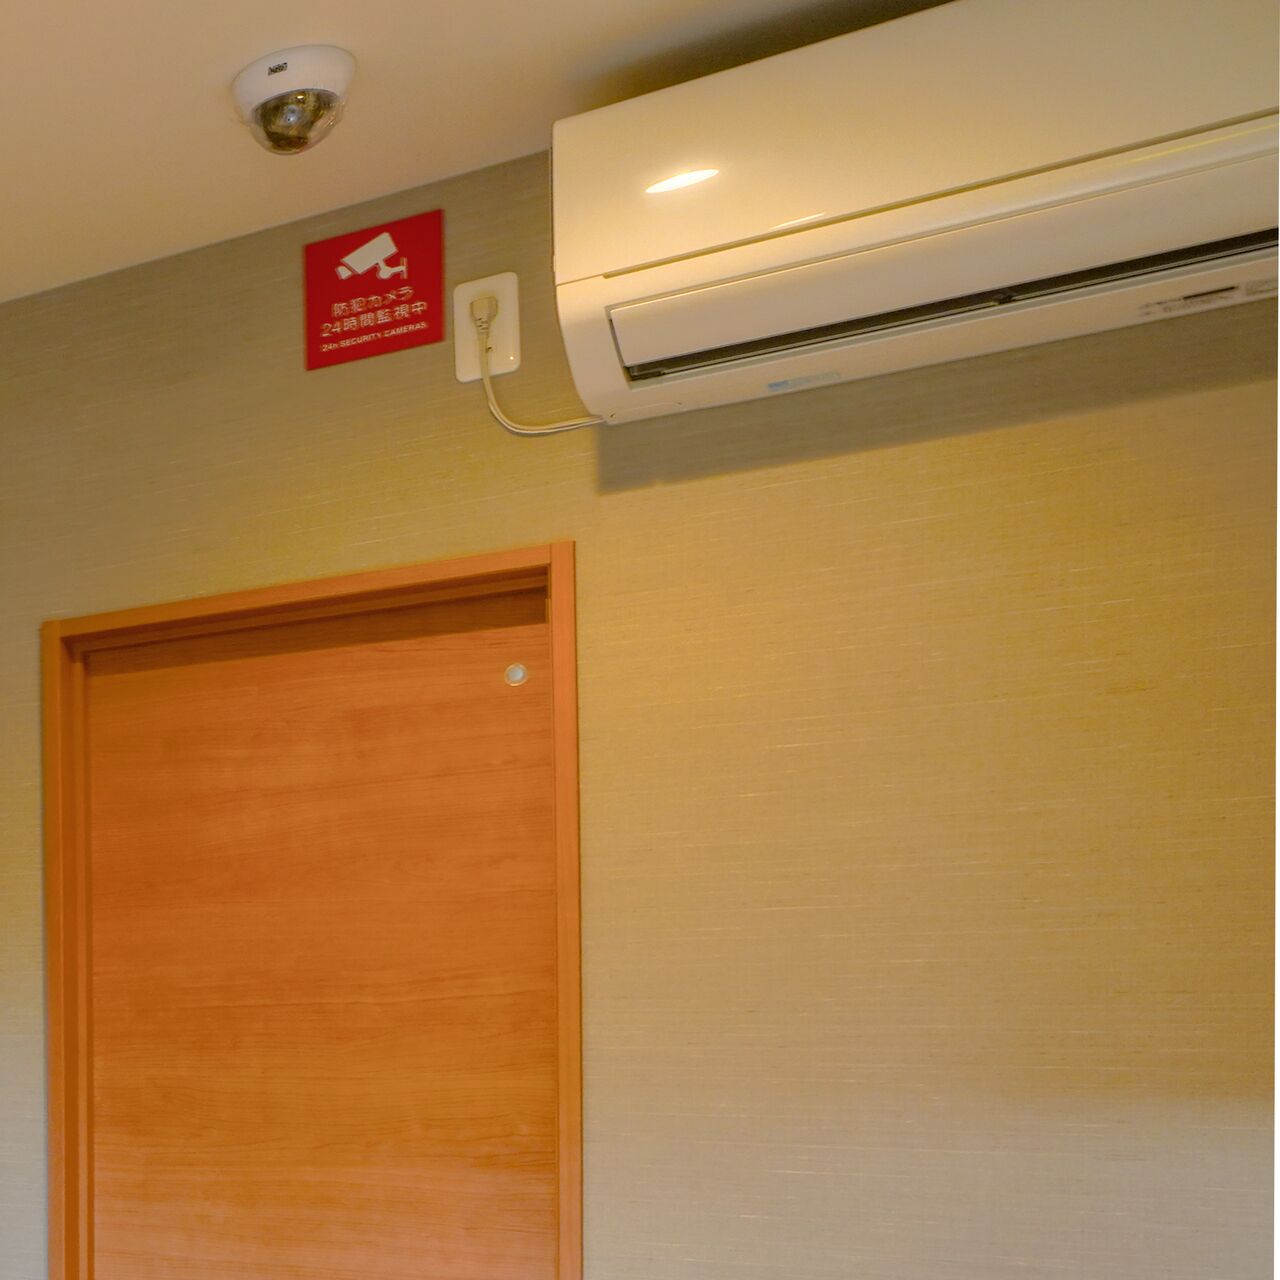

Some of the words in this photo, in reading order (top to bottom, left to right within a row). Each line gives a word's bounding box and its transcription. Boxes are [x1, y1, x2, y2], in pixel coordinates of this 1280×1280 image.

[331, 285, 414, 318] 防犯カメラ
[320, 301, 428, 338] 24時間監視中
[340, 333, 382, 348] SECURITY
[384, 321, 427, 338] CAMERAS
